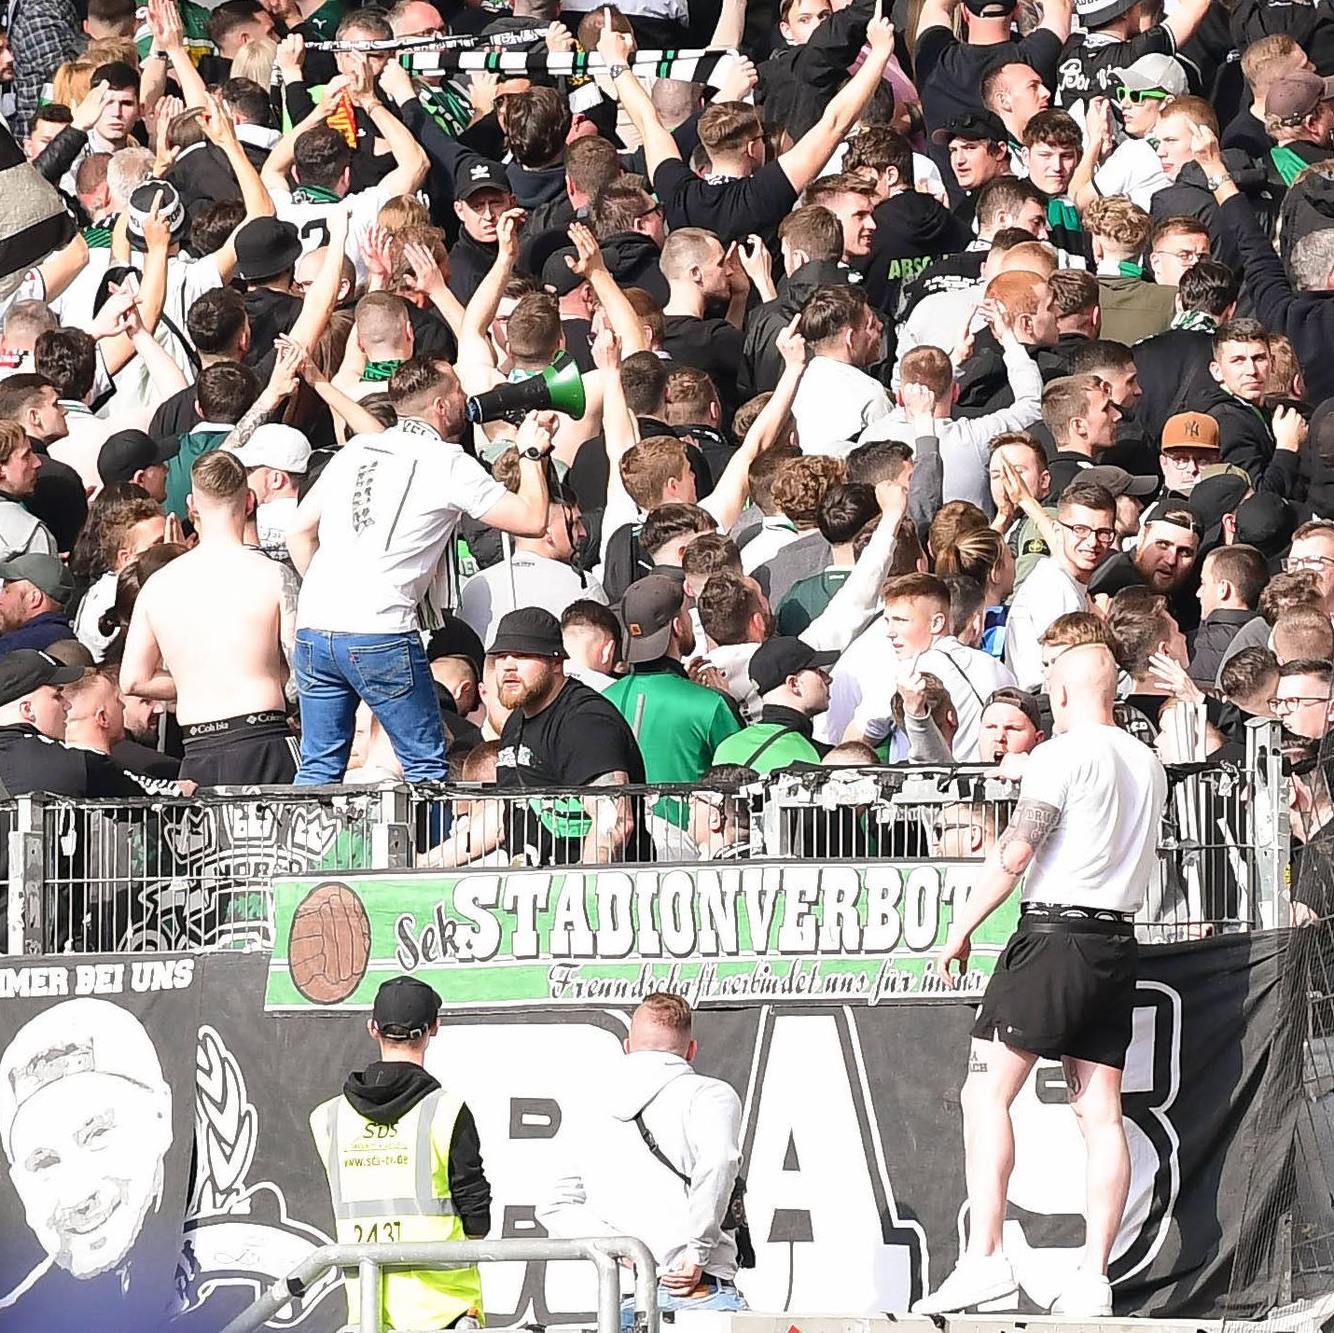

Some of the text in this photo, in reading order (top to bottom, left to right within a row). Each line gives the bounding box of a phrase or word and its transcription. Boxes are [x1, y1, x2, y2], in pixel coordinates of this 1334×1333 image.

[75, 962, 124, 996] BEI
[131, 959, 195, 993] UNS
[723, 957, 823, 993] verbindet
[828, 973, 867, 993] uns
[869, 958, 910, 1003] für
